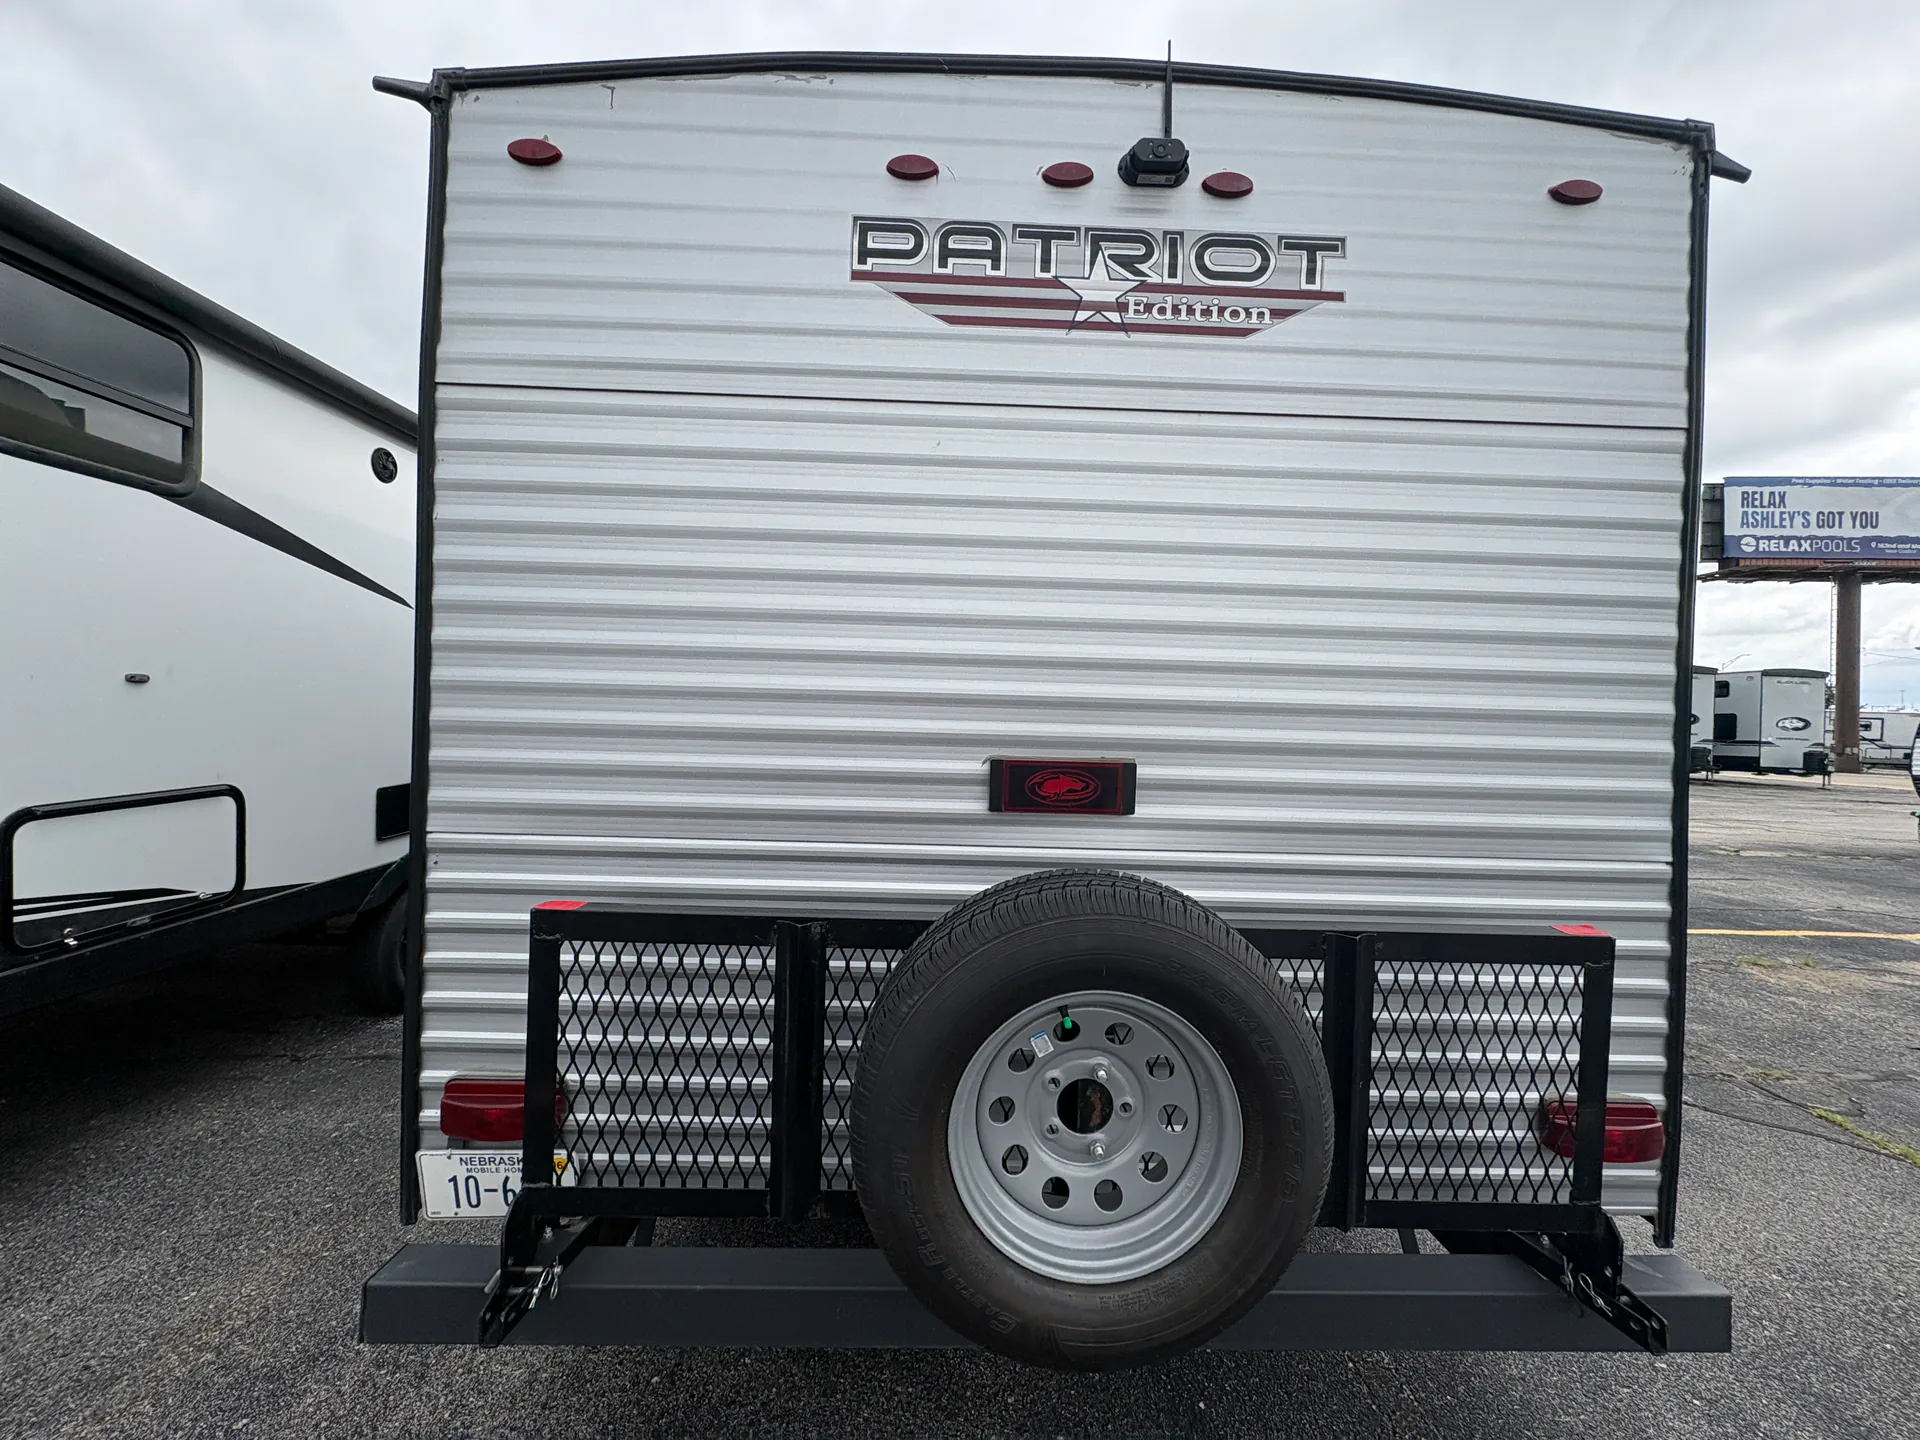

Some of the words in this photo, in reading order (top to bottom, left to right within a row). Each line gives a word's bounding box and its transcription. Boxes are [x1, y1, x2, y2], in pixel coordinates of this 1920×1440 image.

[853, 215, 1346, 291] PATRIOT
[1124, 296, 1273, 325] Edition
[1741, 491, 1787, 508] RELAX
[1740, 511, 1811, 528] ASHLEY'S
[1816, 511, 1845, 529] GOT
[1850, 511, 1879, 529] YOU
[1759, 539, 1861, 553] RELAXPOOLS
[459, 1156, 524, 1166] NEBRASK
[553, 1161, 563, 1170] 6
[448, 1175, 523, 1209] 10-6
